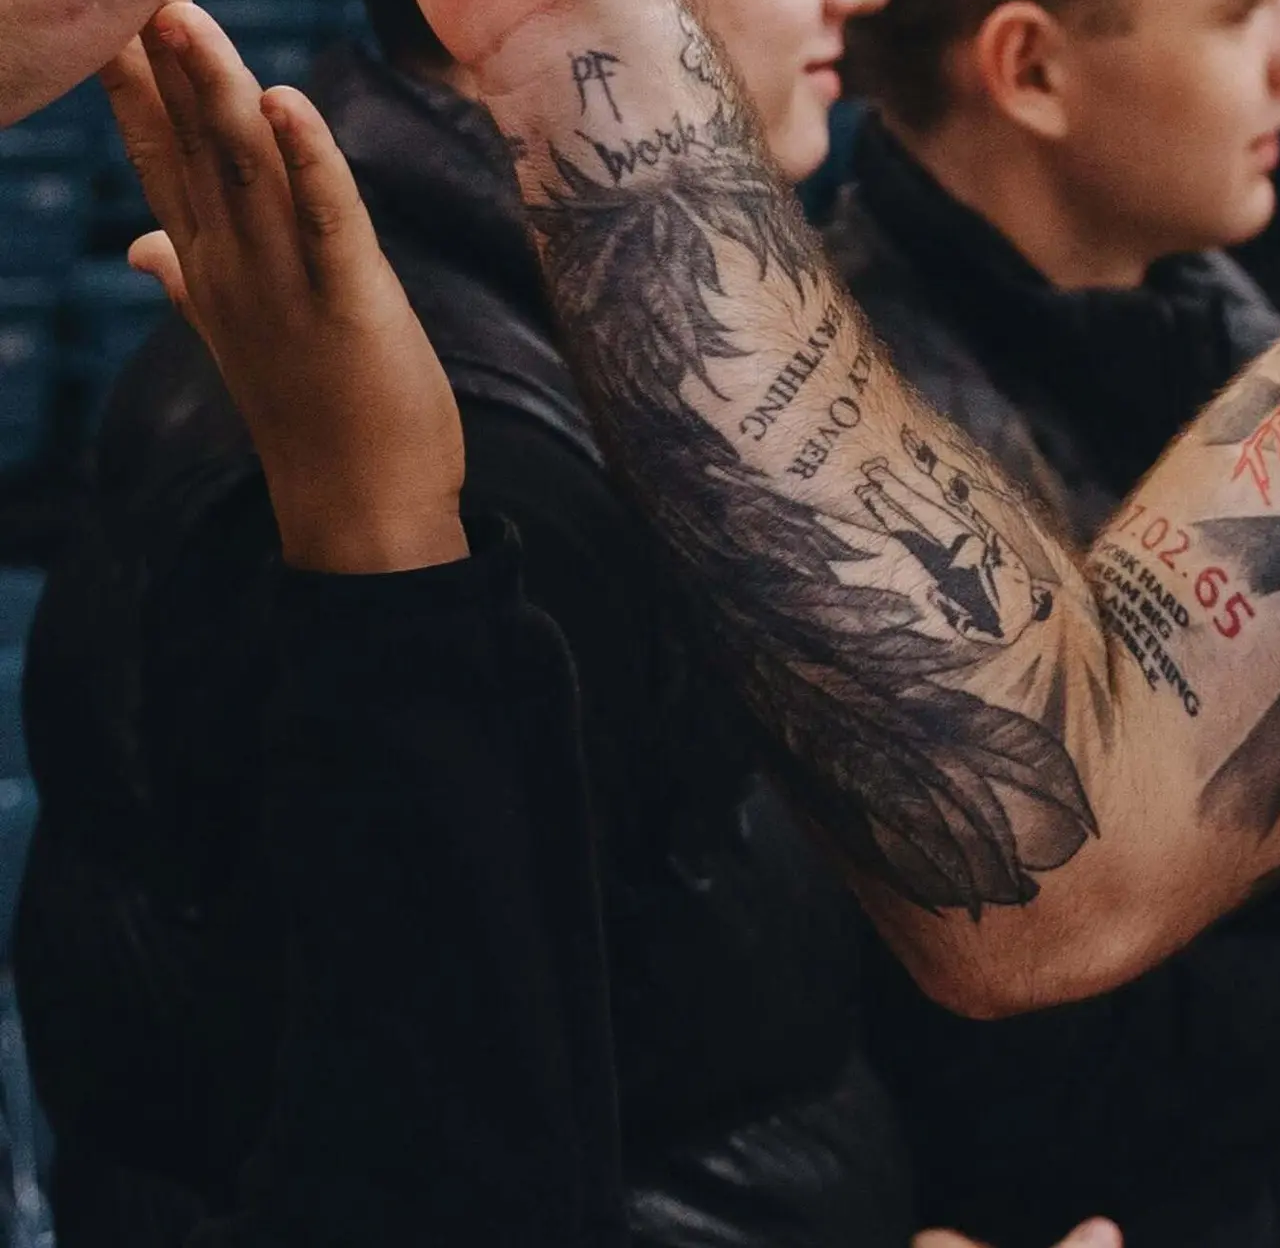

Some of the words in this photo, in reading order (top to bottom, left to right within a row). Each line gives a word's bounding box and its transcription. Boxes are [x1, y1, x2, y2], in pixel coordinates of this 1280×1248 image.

[738, 304, 843, 442] ERYTHING
[1094, 564, 1142, 603] EAM
[1139, 598, 1174, 640] BIG
[1137, 567, 1191, 628] HARD
